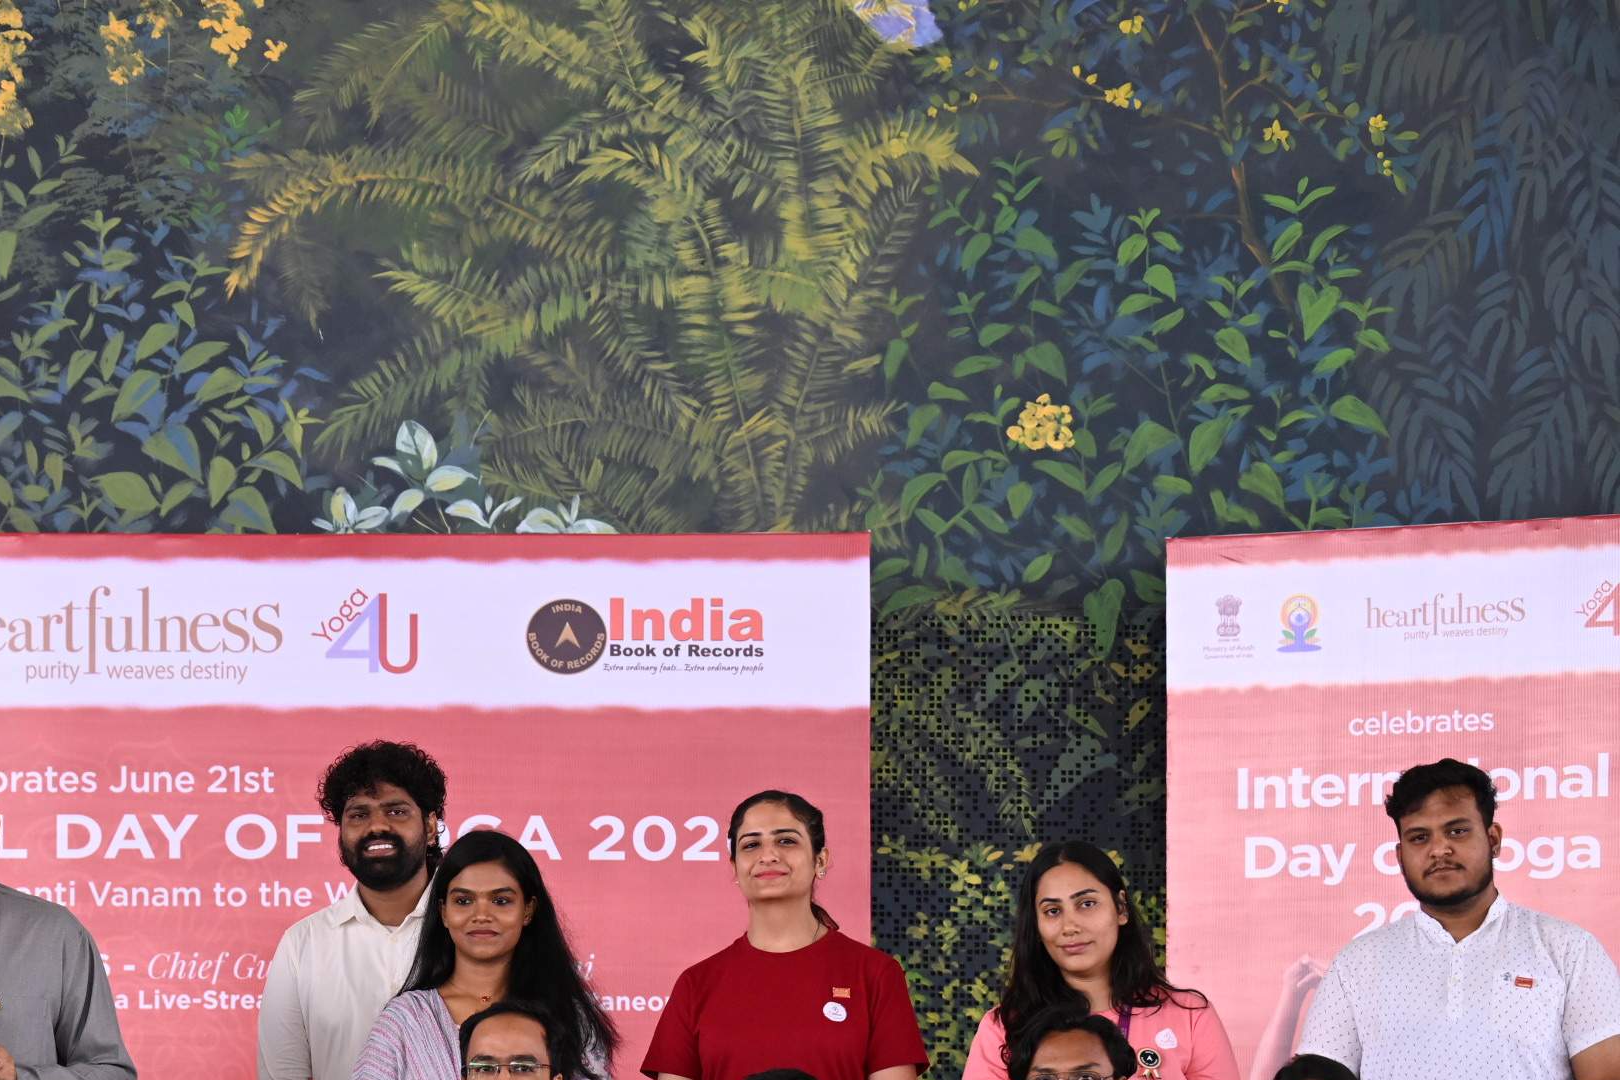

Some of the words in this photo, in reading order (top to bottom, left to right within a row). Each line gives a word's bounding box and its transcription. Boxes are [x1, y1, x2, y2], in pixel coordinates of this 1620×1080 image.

[311, 587, 369, 643] Yoga
[551, 603, 583, 614] INDIA
[1365, 592, 1527, 636] heartfulness
[1574, 580, 1613, 618] Yoga
[325, 592, 419, 675] 4U
[609, 598, 764, 642] India
[528, 632, 550, 665] BOOK
[551, 657, 565, 669] OF
[567, 632, 605, 669] RECORDS
[609, 644, 657, 658] Book
[662, 643, 681, 658] of
[687, 643, 764, 658] Records
[25, 661, 80, 683] purity
[106, 663, 175, 680] weaves
[179, 659, 248, 685] destiny
[1348, 709, 1495, 736] celebrates
[109, 766, 198, 794] June
[207, 765, 275, 794] 21st
[1237, 752, 1610, 810] Internonal
[56, 814, 203, 861] DAY
[224, 813, 324, 861] OF
[587, 815, 732, 862] 202
[1244, 835, 1356, 886] Day
[1496, 834, 1601, 880] oga
[88, 881, 201, 908] Vanam
[213, 882, 247, 907] to
[259, 880, 313, 907] the
[147, 951, 230, 985] Chief
